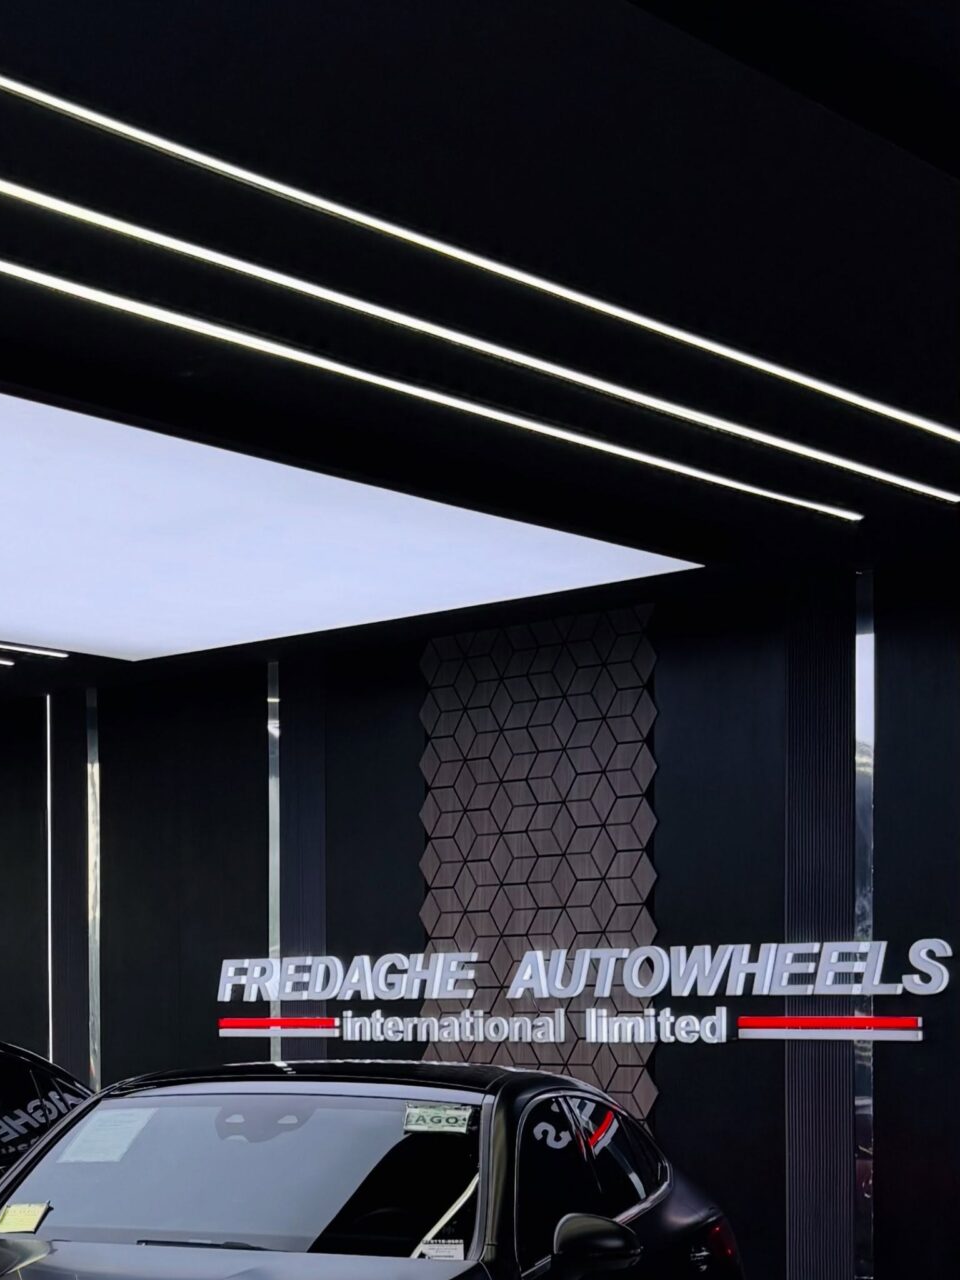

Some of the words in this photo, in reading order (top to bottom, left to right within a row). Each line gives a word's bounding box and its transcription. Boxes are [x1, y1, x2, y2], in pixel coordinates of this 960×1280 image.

[217, 952, 478, 1002] FREDAGHE
[506, 938, 953, 999] AUTOWHEELS
[343, 1009, 565, 1042] international
[585, 1006, 727, 1043] limited
